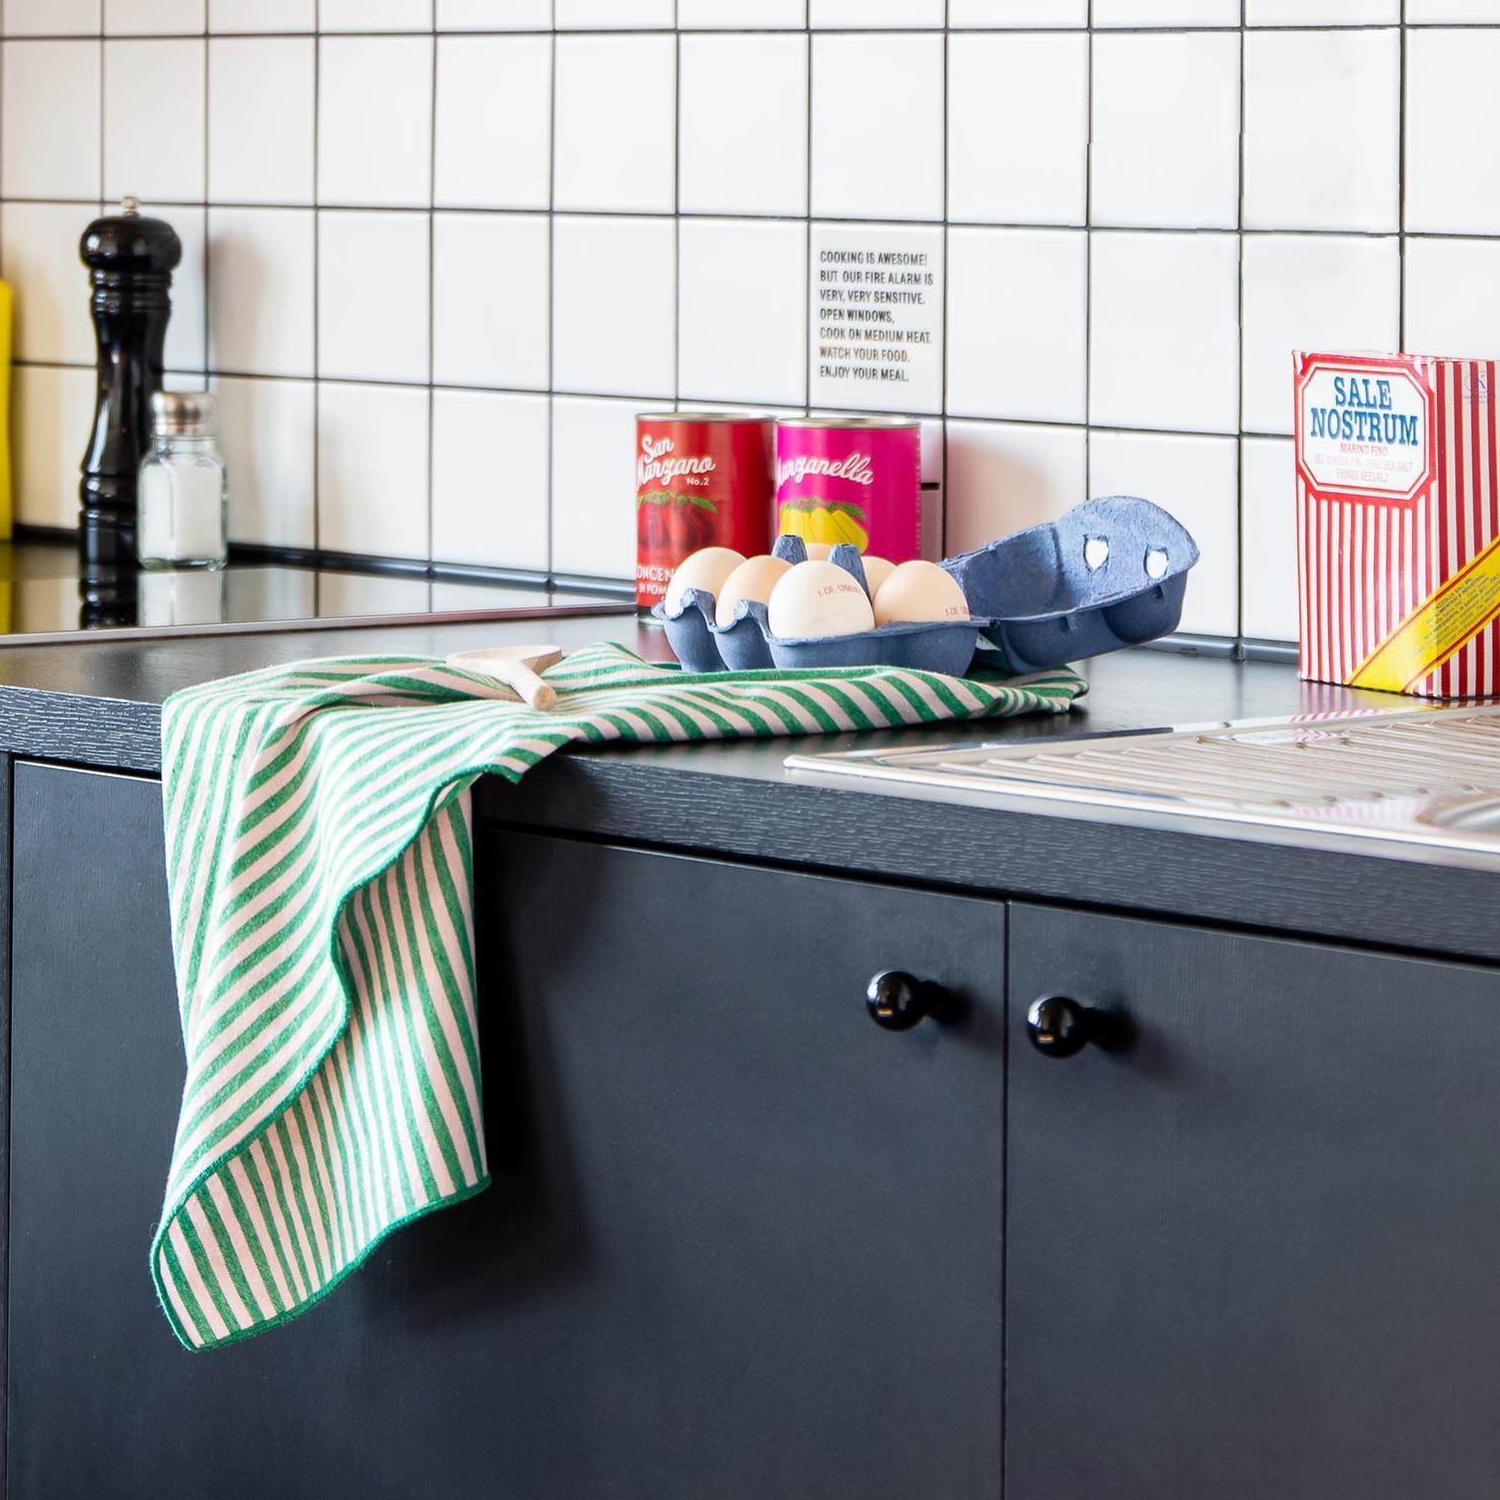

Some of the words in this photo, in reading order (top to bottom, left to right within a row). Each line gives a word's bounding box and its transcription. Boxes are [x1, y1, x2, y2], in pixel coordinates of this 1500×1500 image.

[820, 250, 864, 265] COOKING
[866, 252, 875, 265] IS
[877, 252, 928, 266] AWESOME!
[820, 270, 838, 283] BUT
[842, 270, 863, 284] OUR
[865, 271, 886, 285] FIRE
[888, 272, 921, 286] ALARM
[924, 273, 934, 286] IS
[820, 289, 845, 304] VERY,
[847, 290, 872, 303] VERY
[873, 291, 926, 306] SENSITIVE.
[820, 308, 845, 321] OPEN
[820, 327, 846, 340] COOK
[848, 328, 862, 340] ON
[864, 329, 904, 343] MEDIUM
[906, 331, 932, 344] HEAT.
[819, 346, 850, 360] WATCH
[853, 347, 879, 361] YOUR
[820, 365, 850, 379] ENJOY
[852, 366, 877, 380] YOUR
[880, 368, 910, 382] MEAL.
[1334, 376, 1392, 410] SALE
[1310, 407, 1419, 446] NOSTRUM
[641, 434, 675, 464] San
[686, 477, 709, 486] No.2
[636, 565, 675, 582] ONCEN
